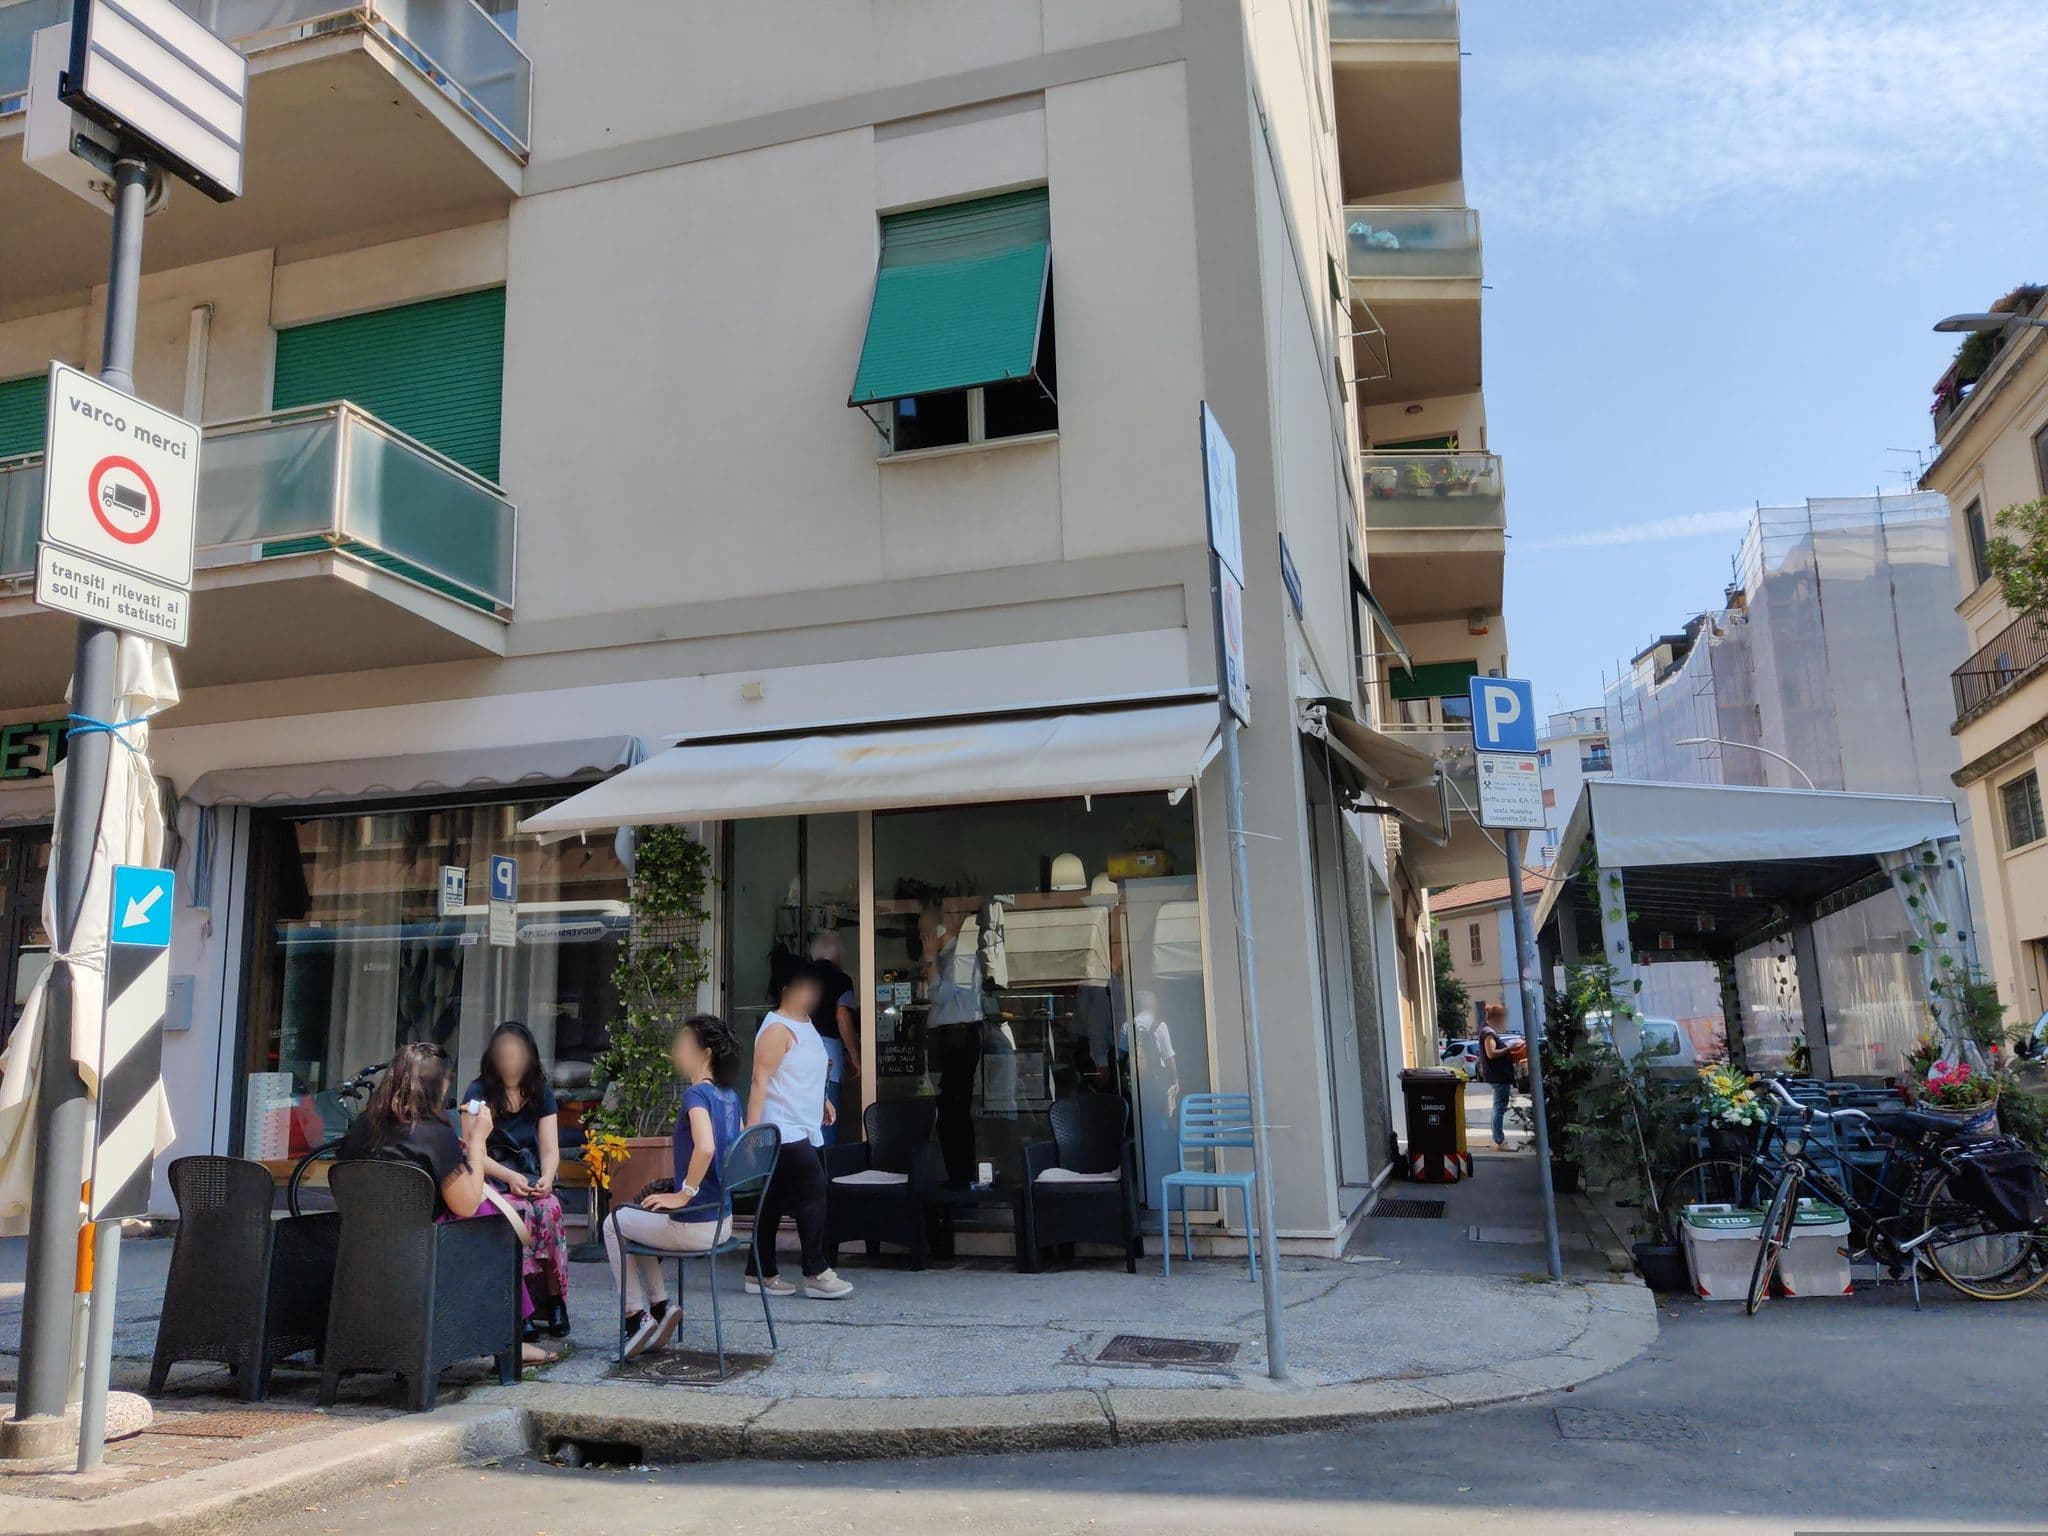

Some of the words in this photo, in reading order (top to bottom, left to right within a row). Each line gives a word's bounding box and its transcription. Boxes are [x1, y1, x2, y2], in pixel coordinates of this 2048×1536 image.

[69, 395, 127, 432] varco
[134, 425, 188, 459] merci
[51, 561, 105, 591] transiti
[112, 582, 161, 608] rilevati
[167, 600, 179, 615] ai
[52, 580, 79, 600] soli
[86, 590, 110, 610] fini
[117, 601, 177, 630] statistici
[1484, 685, 1521, 743] P
